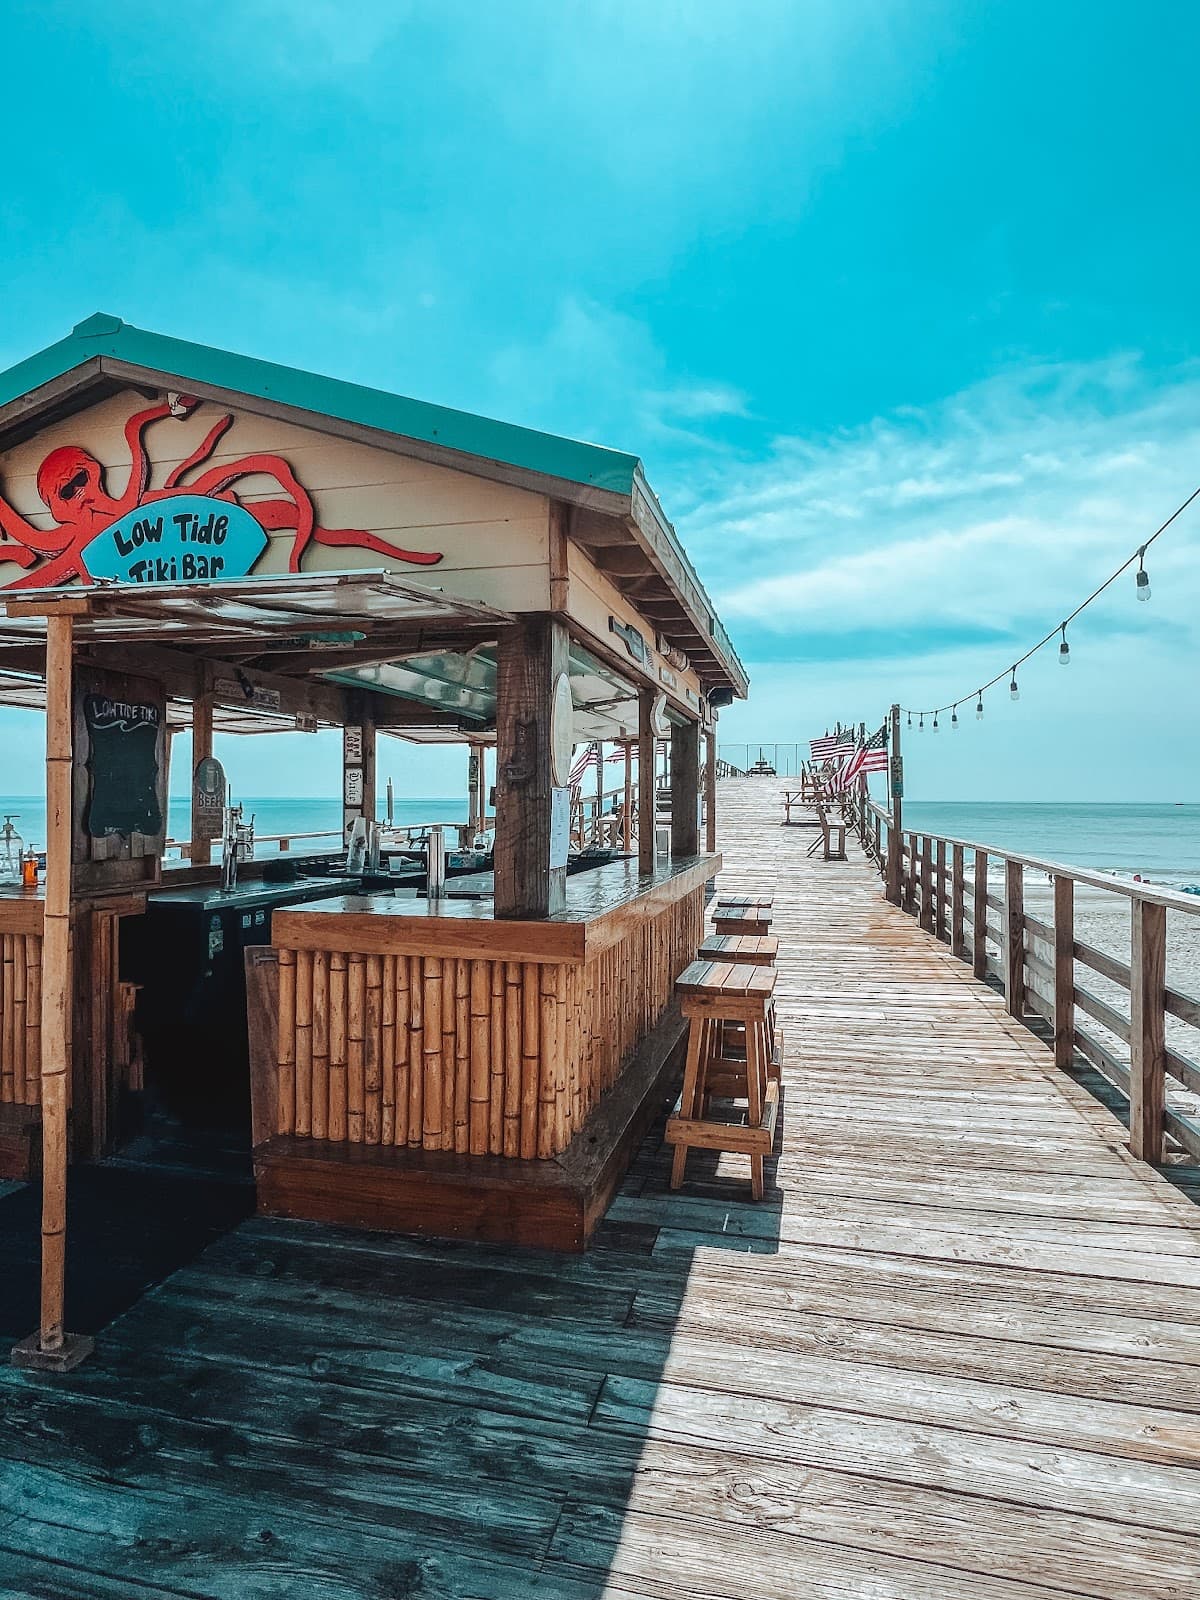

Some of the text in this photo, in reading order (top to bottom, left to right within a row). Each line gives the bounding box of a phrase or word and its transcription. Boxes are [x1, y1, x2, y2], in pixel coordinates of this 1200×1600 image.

[113, 513, 229, 557] Low Tide
[128, 553, 225, 583] Tiki Bar
[139, 705, 158, 721] TIKI
[198, 791, 224, 808] BEER
